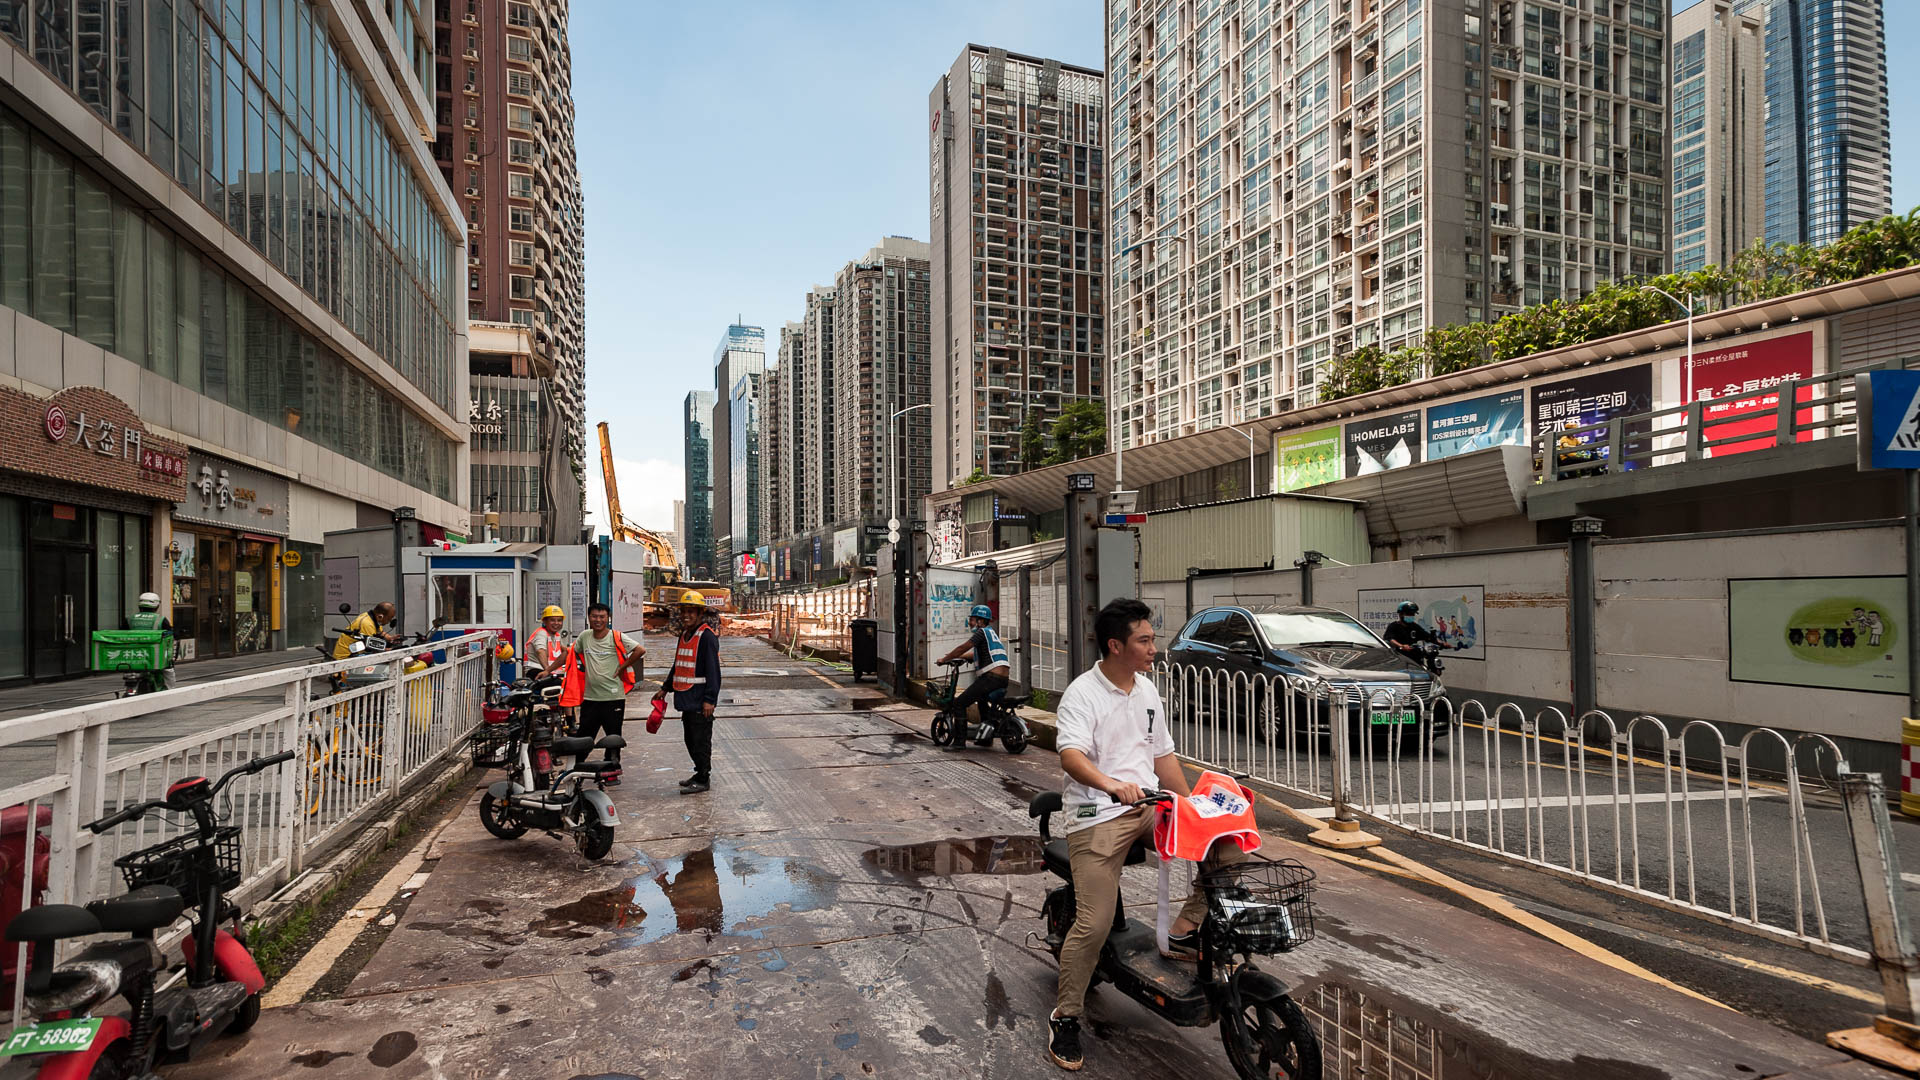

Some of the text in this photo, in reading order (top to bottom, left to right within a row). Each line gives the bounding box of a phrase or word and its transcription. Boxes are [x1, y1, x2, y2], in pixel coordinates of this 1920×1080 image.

[1538, 391, 1627, 420] 星河第三空间
[1432, 413, 1478, 429] 星河第三空间
[1354, 424, 1407, 442] HOMELAB
